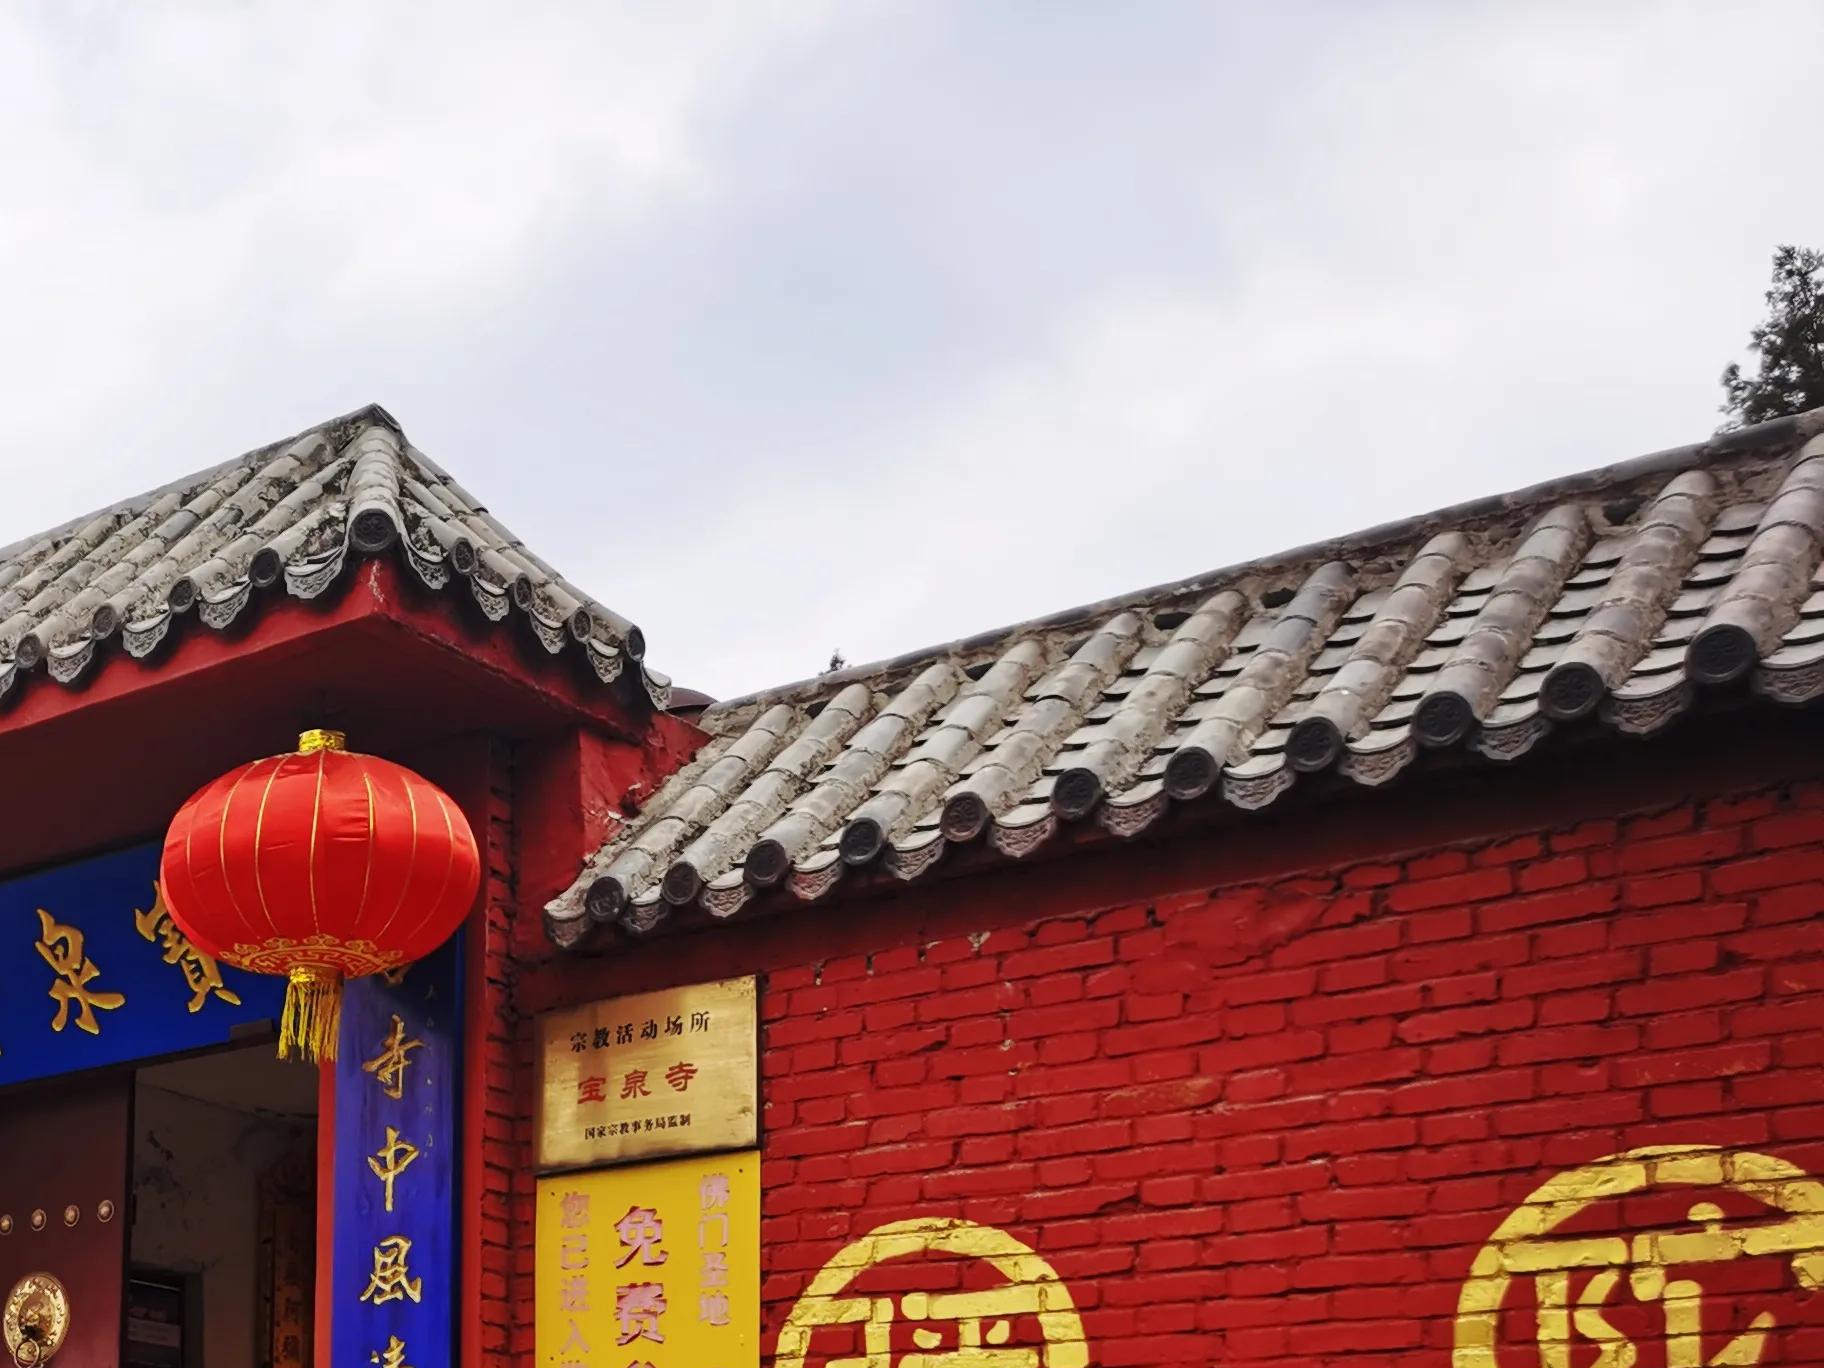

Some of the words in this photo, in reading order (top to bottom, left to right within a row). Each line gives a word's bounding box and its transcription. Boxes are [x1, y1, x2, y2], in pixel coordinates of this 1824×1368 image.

[570, 1011, 711, 1053] 宗教活动场所
[577, 1061, 699, 1105] 宝泉寺
[584, 1113, 691, 1140] 国家宗教事务局监制
[698, 1171, 732, 1327] 佛门圣地
